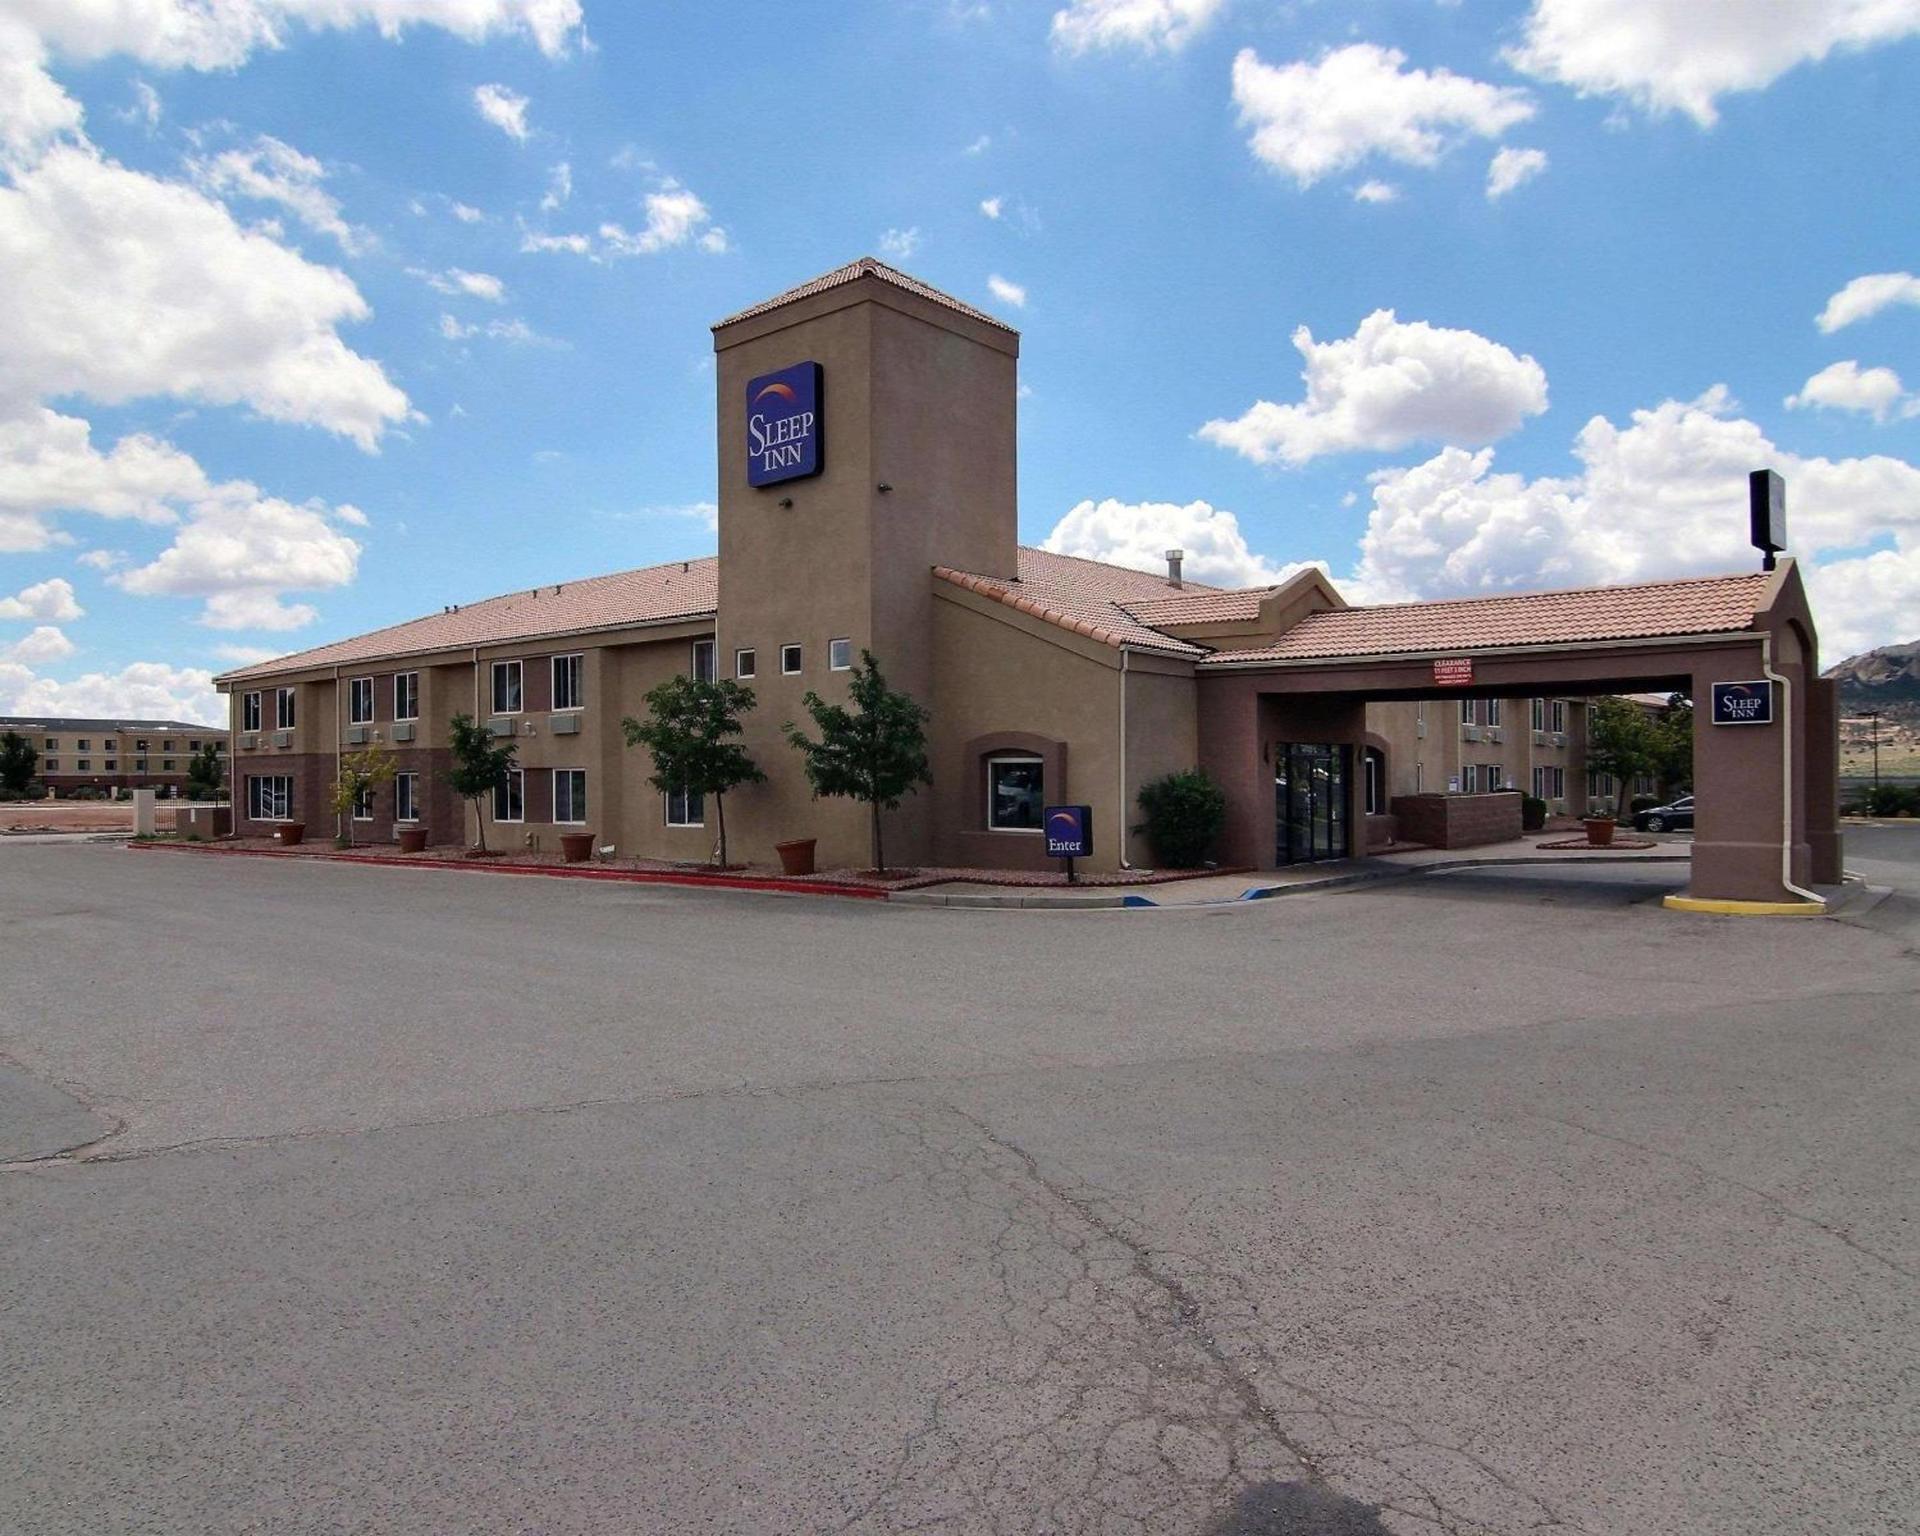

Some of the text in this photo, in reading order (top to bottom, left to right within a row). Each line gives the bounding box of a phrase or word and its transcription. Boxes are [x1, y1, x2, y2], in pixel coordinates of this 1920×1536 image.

[749, 411, 814, 457] SLEEP
[763, 442, 802, 472] INN
[1723, 695, 1761, 712] SLEEP
[1732, 708, 1755, 718] INN
[1049, 838, 1081, 851] Enter
